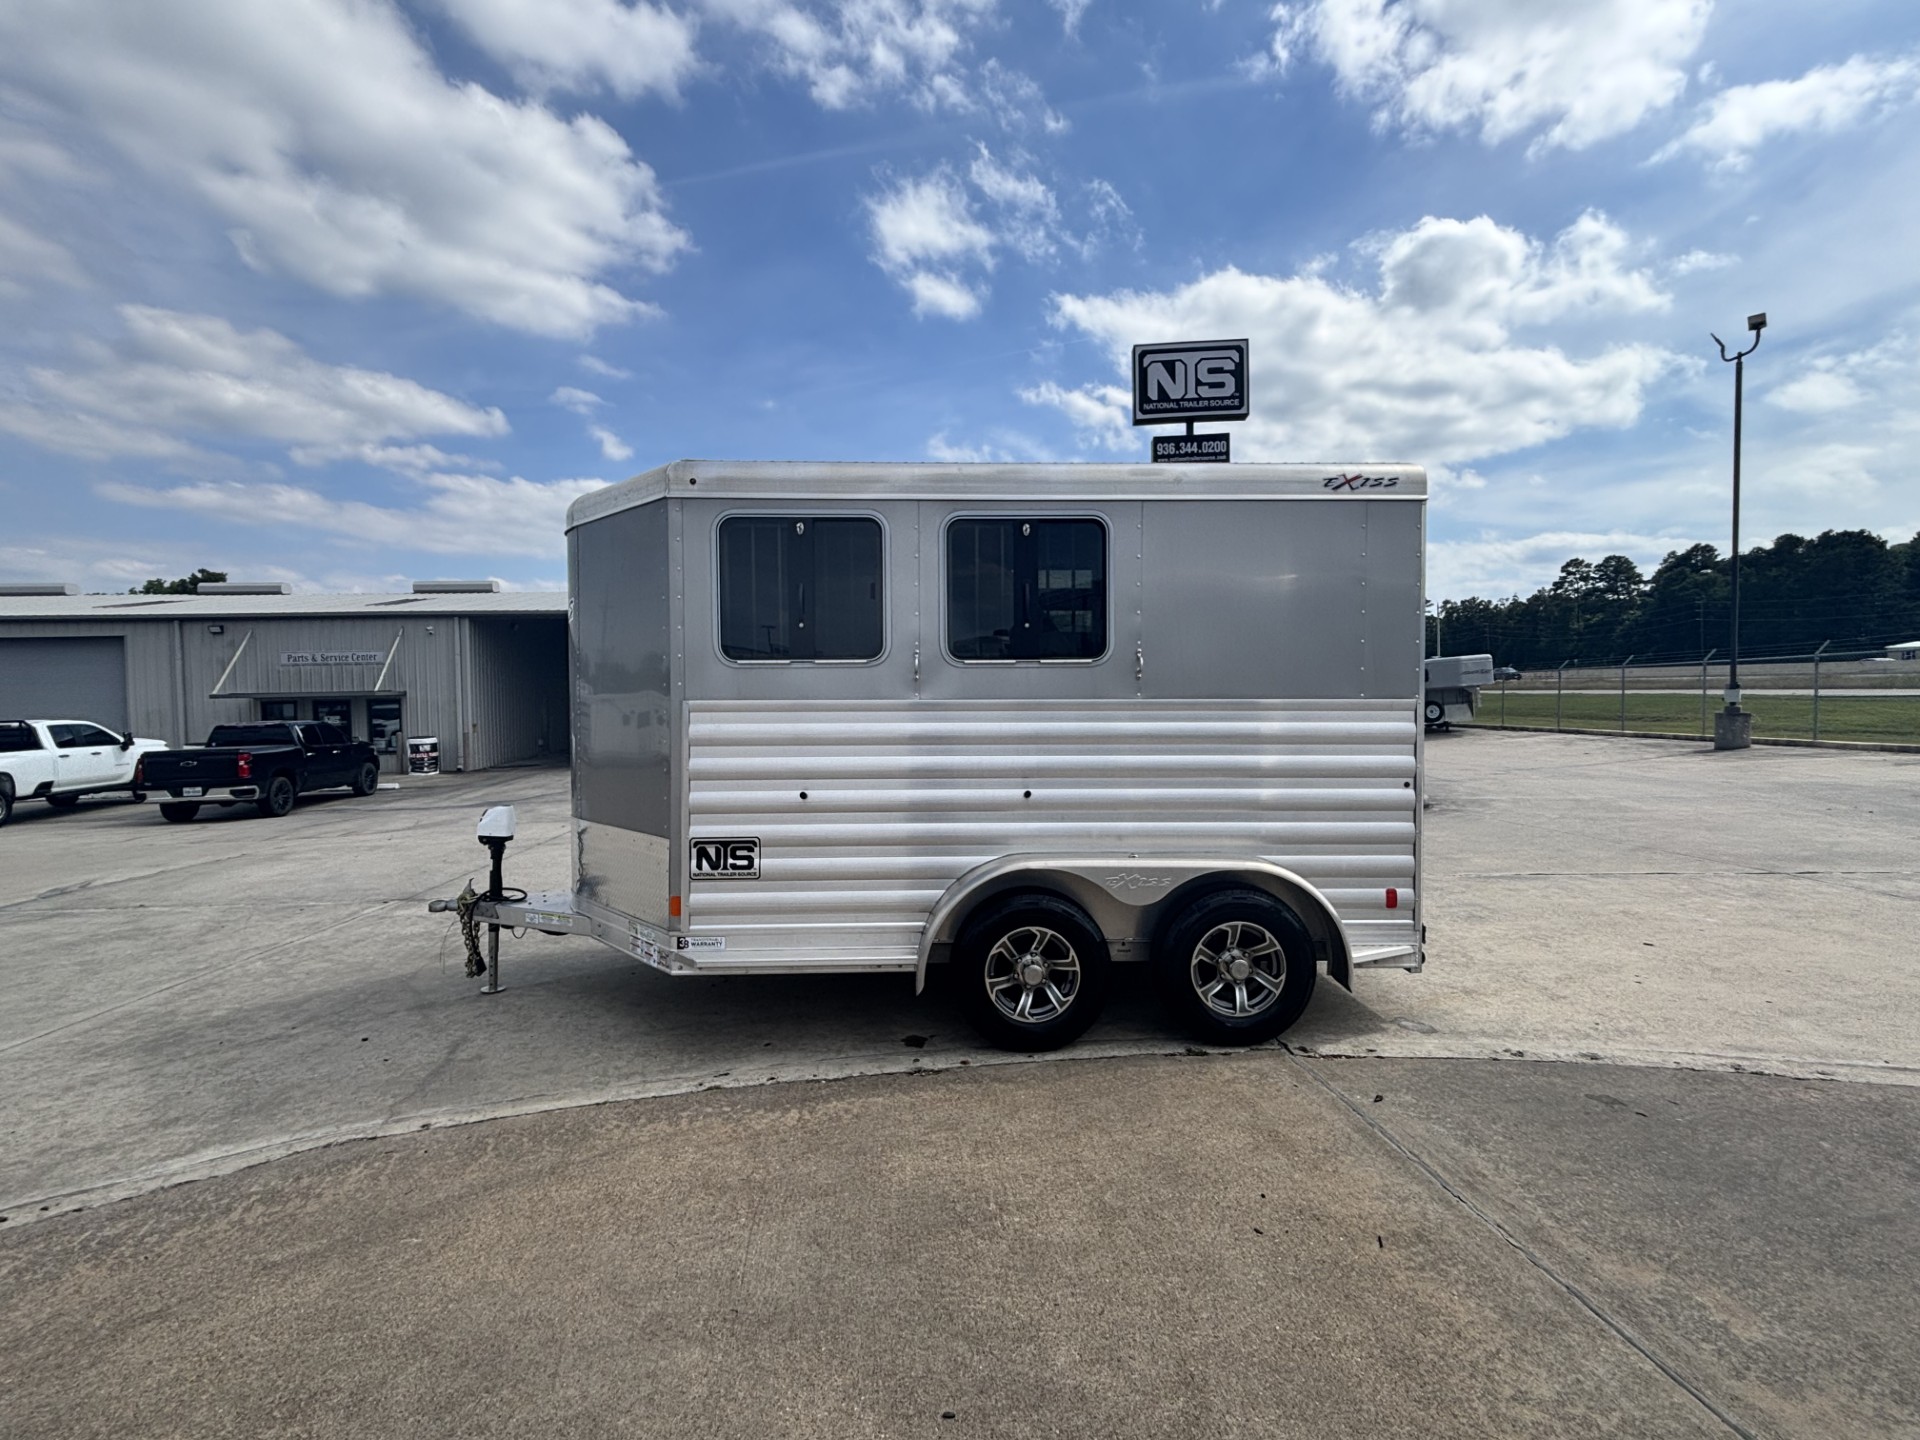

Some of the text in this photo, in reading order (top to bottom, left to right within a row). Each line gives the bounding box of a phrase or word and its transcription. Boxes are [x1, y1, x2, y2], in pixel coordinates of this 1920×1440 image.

[1143, 350, 1240, 401] NTS
[1143, 399, 1240, 410] NATIONAL TRAILER SOURCE
[1156, 440, 1227, 455] 936.344.0200
[287, 652, 377, 663] Parts & Service Center
[693, 840, 758, 871] NTS
